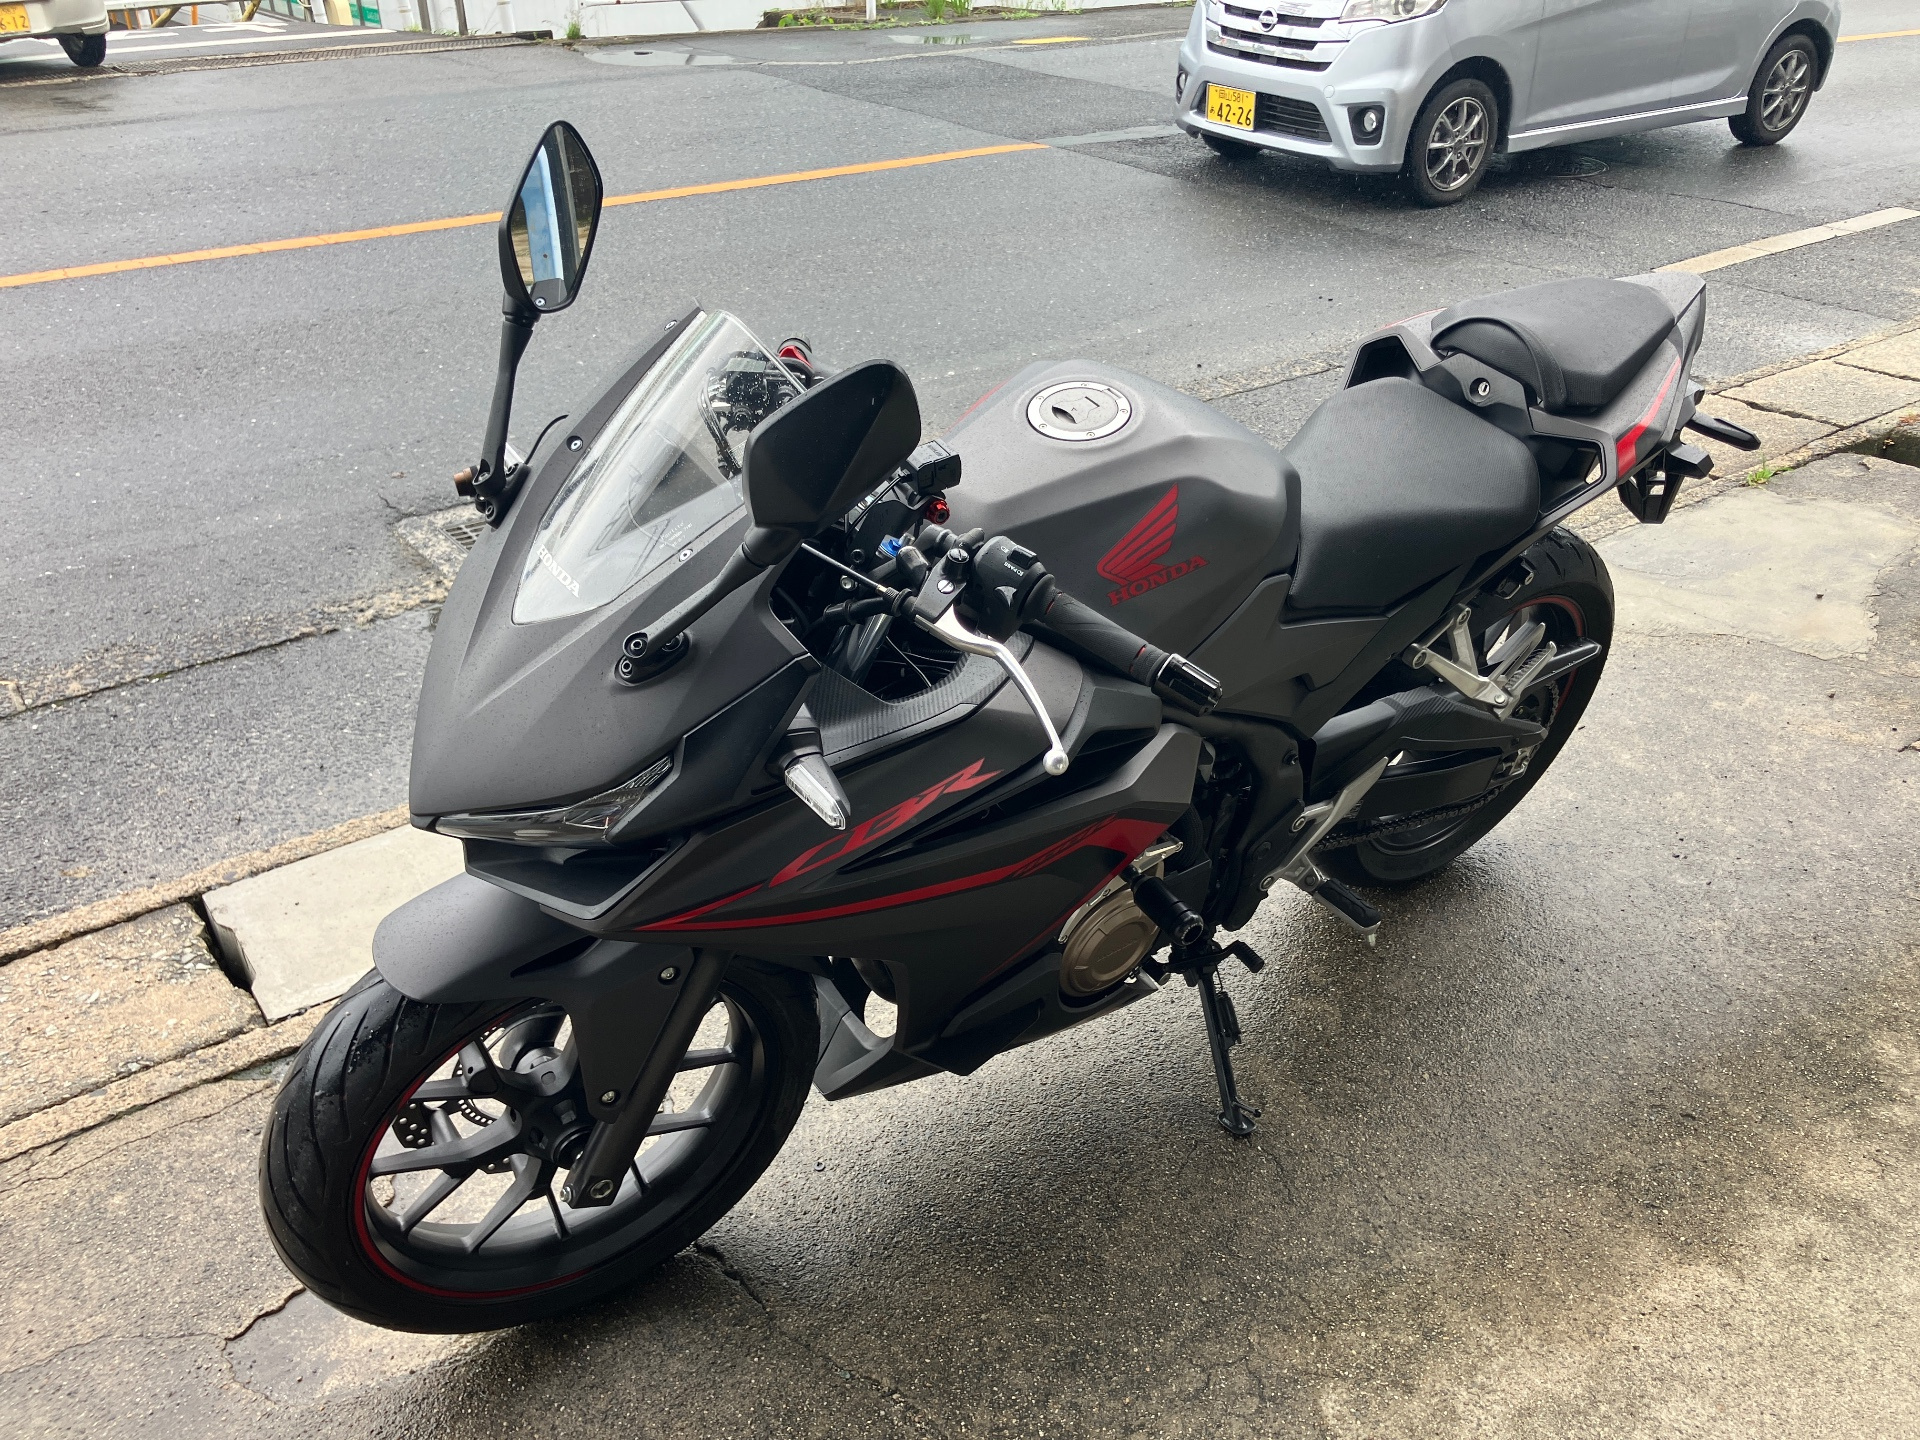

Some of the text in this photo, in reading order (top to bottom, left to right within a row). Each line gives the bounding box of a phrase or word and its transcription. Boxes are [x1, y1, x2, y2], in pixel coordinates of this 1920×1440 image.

[1217, 102, 1252, 126] 42-26
[536, 544, 580, 598] HONDA
[1107, 554, 1210, 606] HONDA
[769, 758, 1004, 888] CBR
